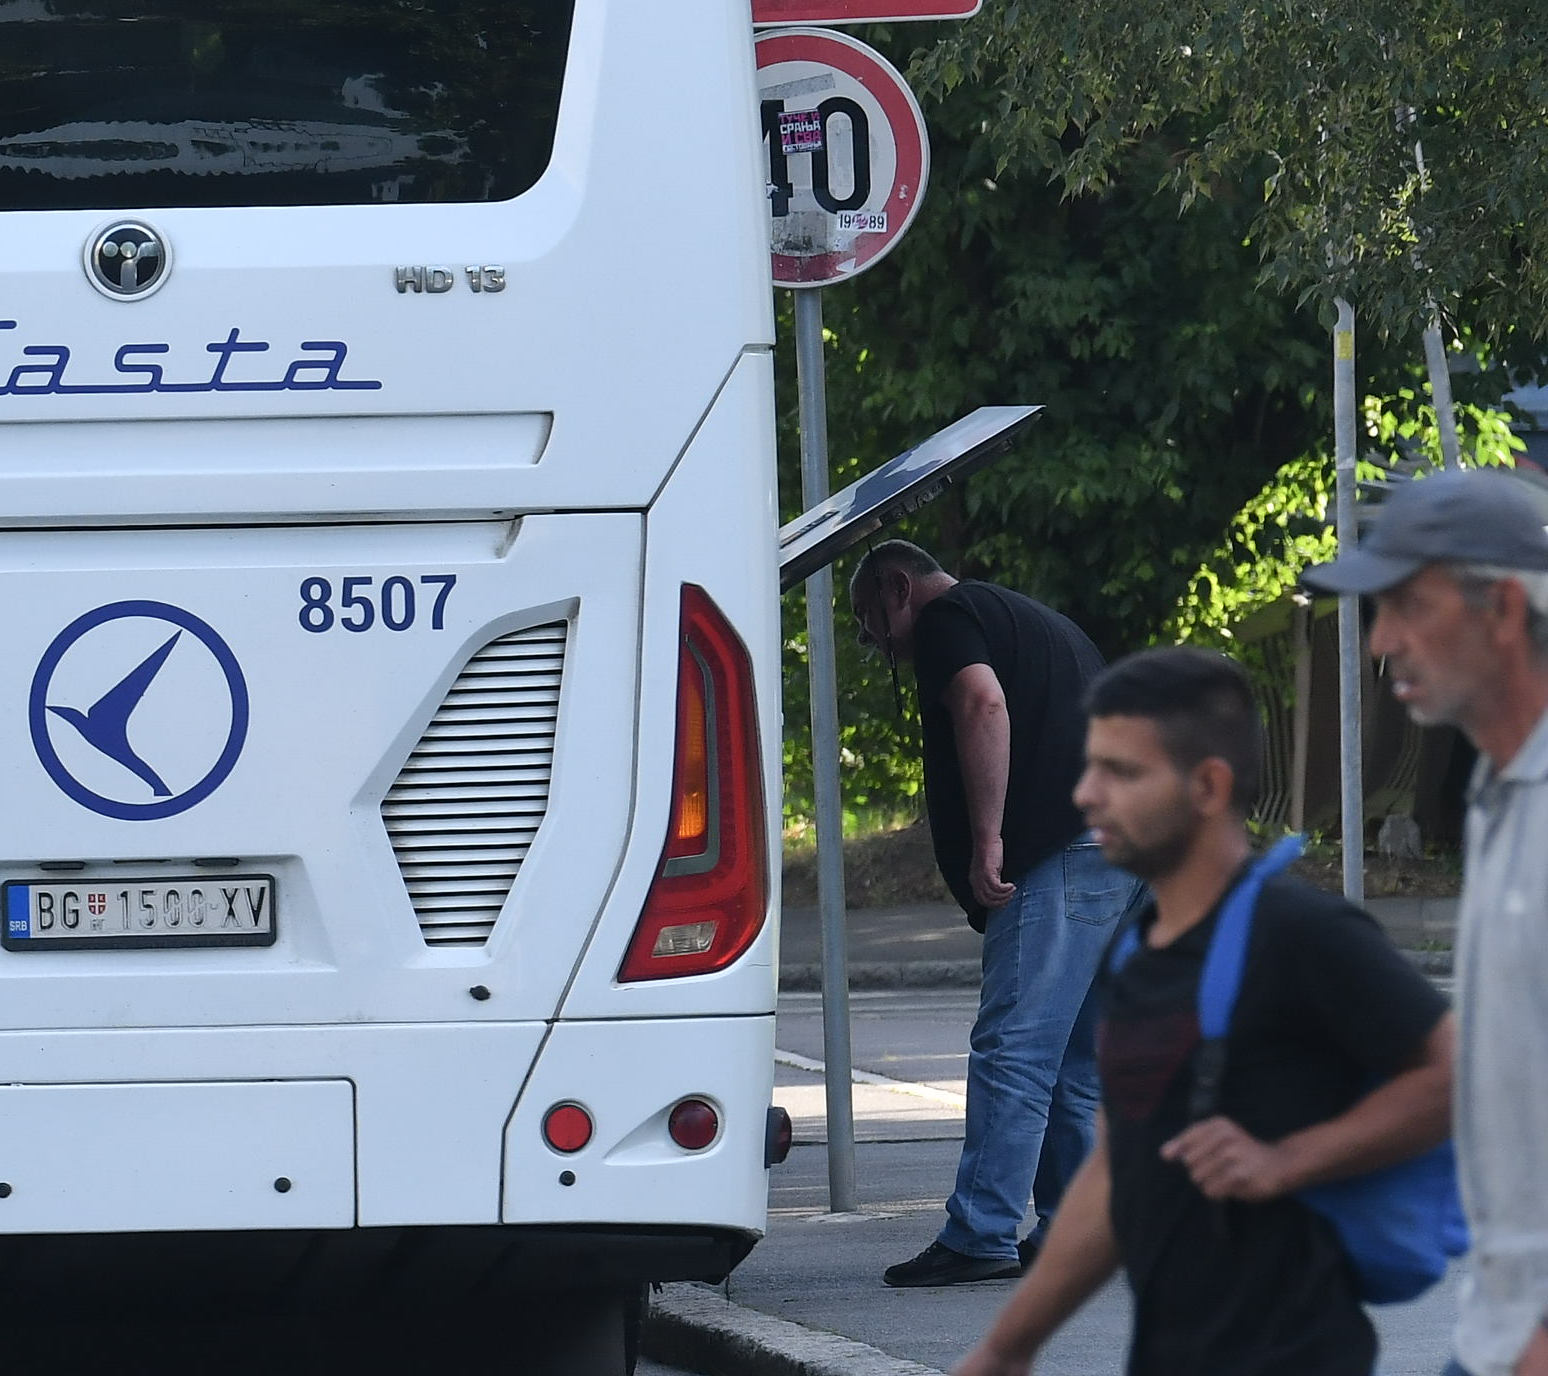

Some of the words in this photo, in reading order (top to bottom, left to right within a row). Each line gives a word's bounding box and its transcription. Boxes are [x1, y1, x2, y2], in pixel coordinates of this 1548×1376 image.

[395, 266, 454, 293] HD
[464, 265, 506, 293] 13
[298, 573, 457, 633] 8507
[9, 920, 28, 931] SRB
[38, 891, 79, 931] BG
